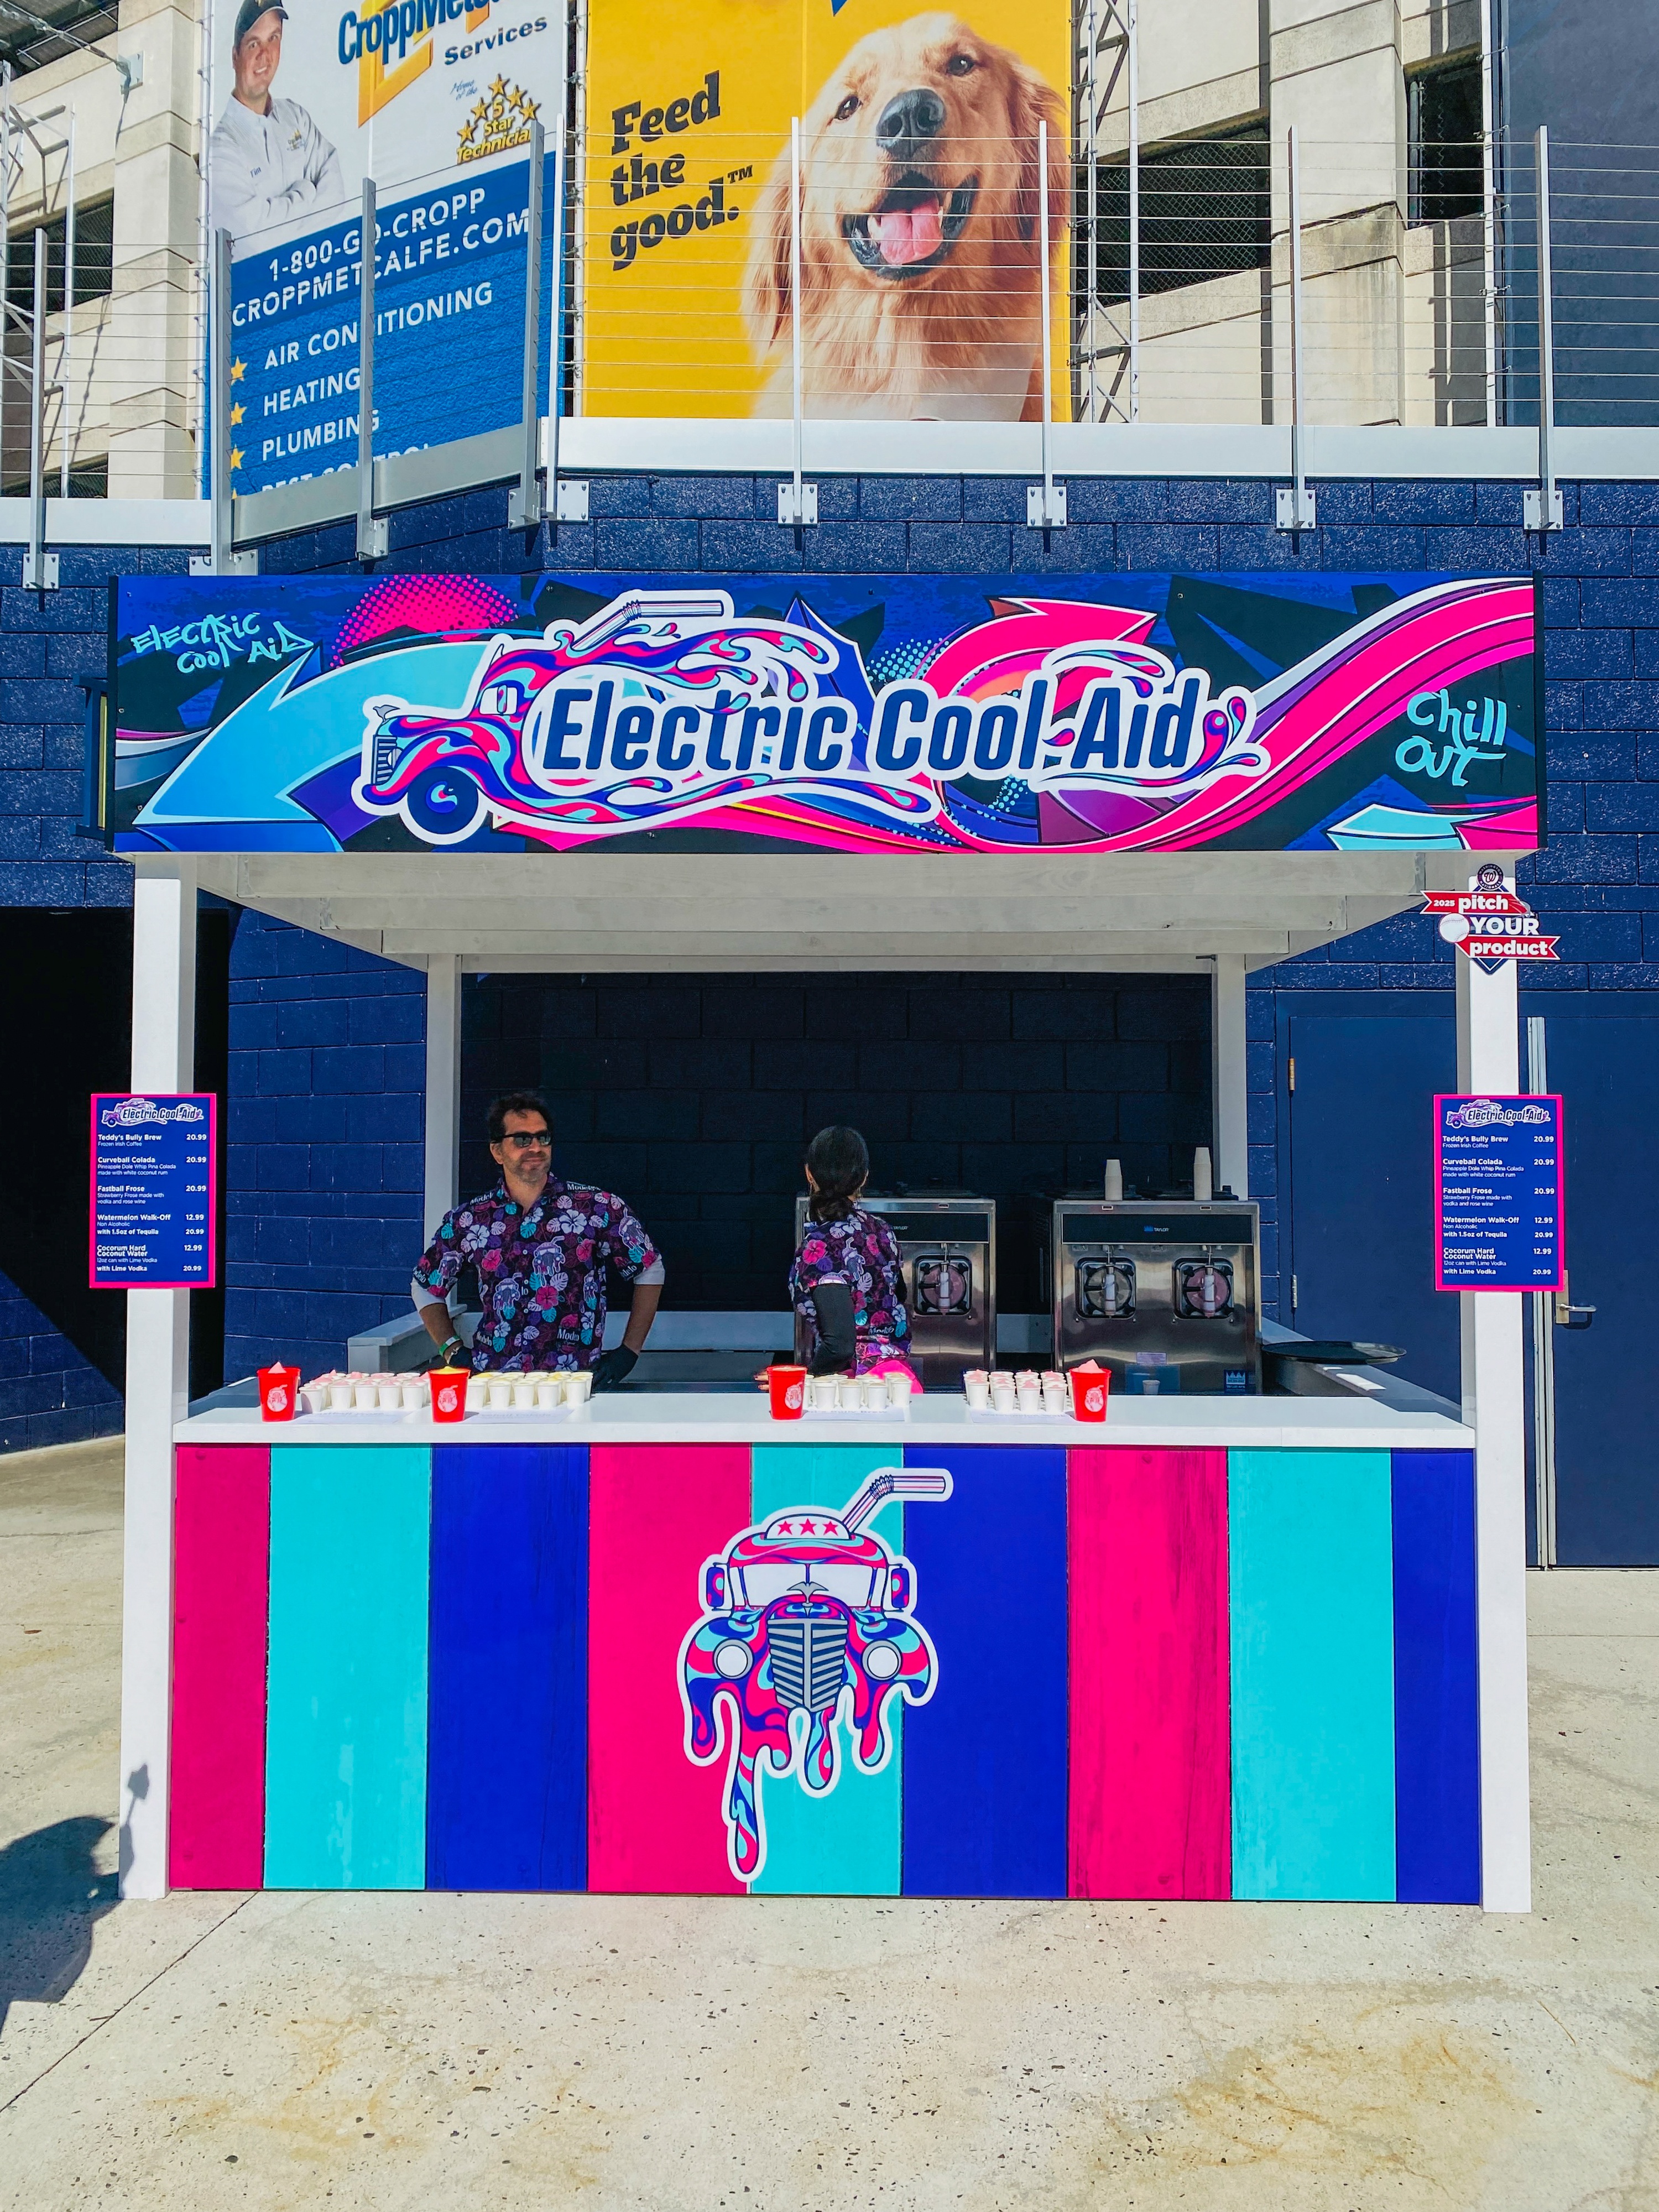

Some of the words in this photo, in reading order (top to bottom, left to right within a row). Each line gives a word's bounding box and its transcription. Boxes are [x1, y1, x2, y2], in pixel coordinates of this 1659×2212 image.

[445, 17, 547, 65] Services
[492, 98, 504, 119] 5
[612, 70, 721, 155] Feed
[483, 116, 516, 137] Star
[456, 127, 531, 165] Technicia
[610, 152, 685, 206] the
[264, 341, 299, 370] AIR
[307, 281, 493, 357] CONITIONING
[263, 367, 361, 416] HEATING
[542, 680, 848, 771] Electric
[1458, 895, 1509, 913] pitch
[1469, 916, 1540, 935] YOUR
[1469, 940, 1548, 957] product
[123, 1109, 157, 1119] Electric
[1468, 1110, 1504, 1120] Electric
